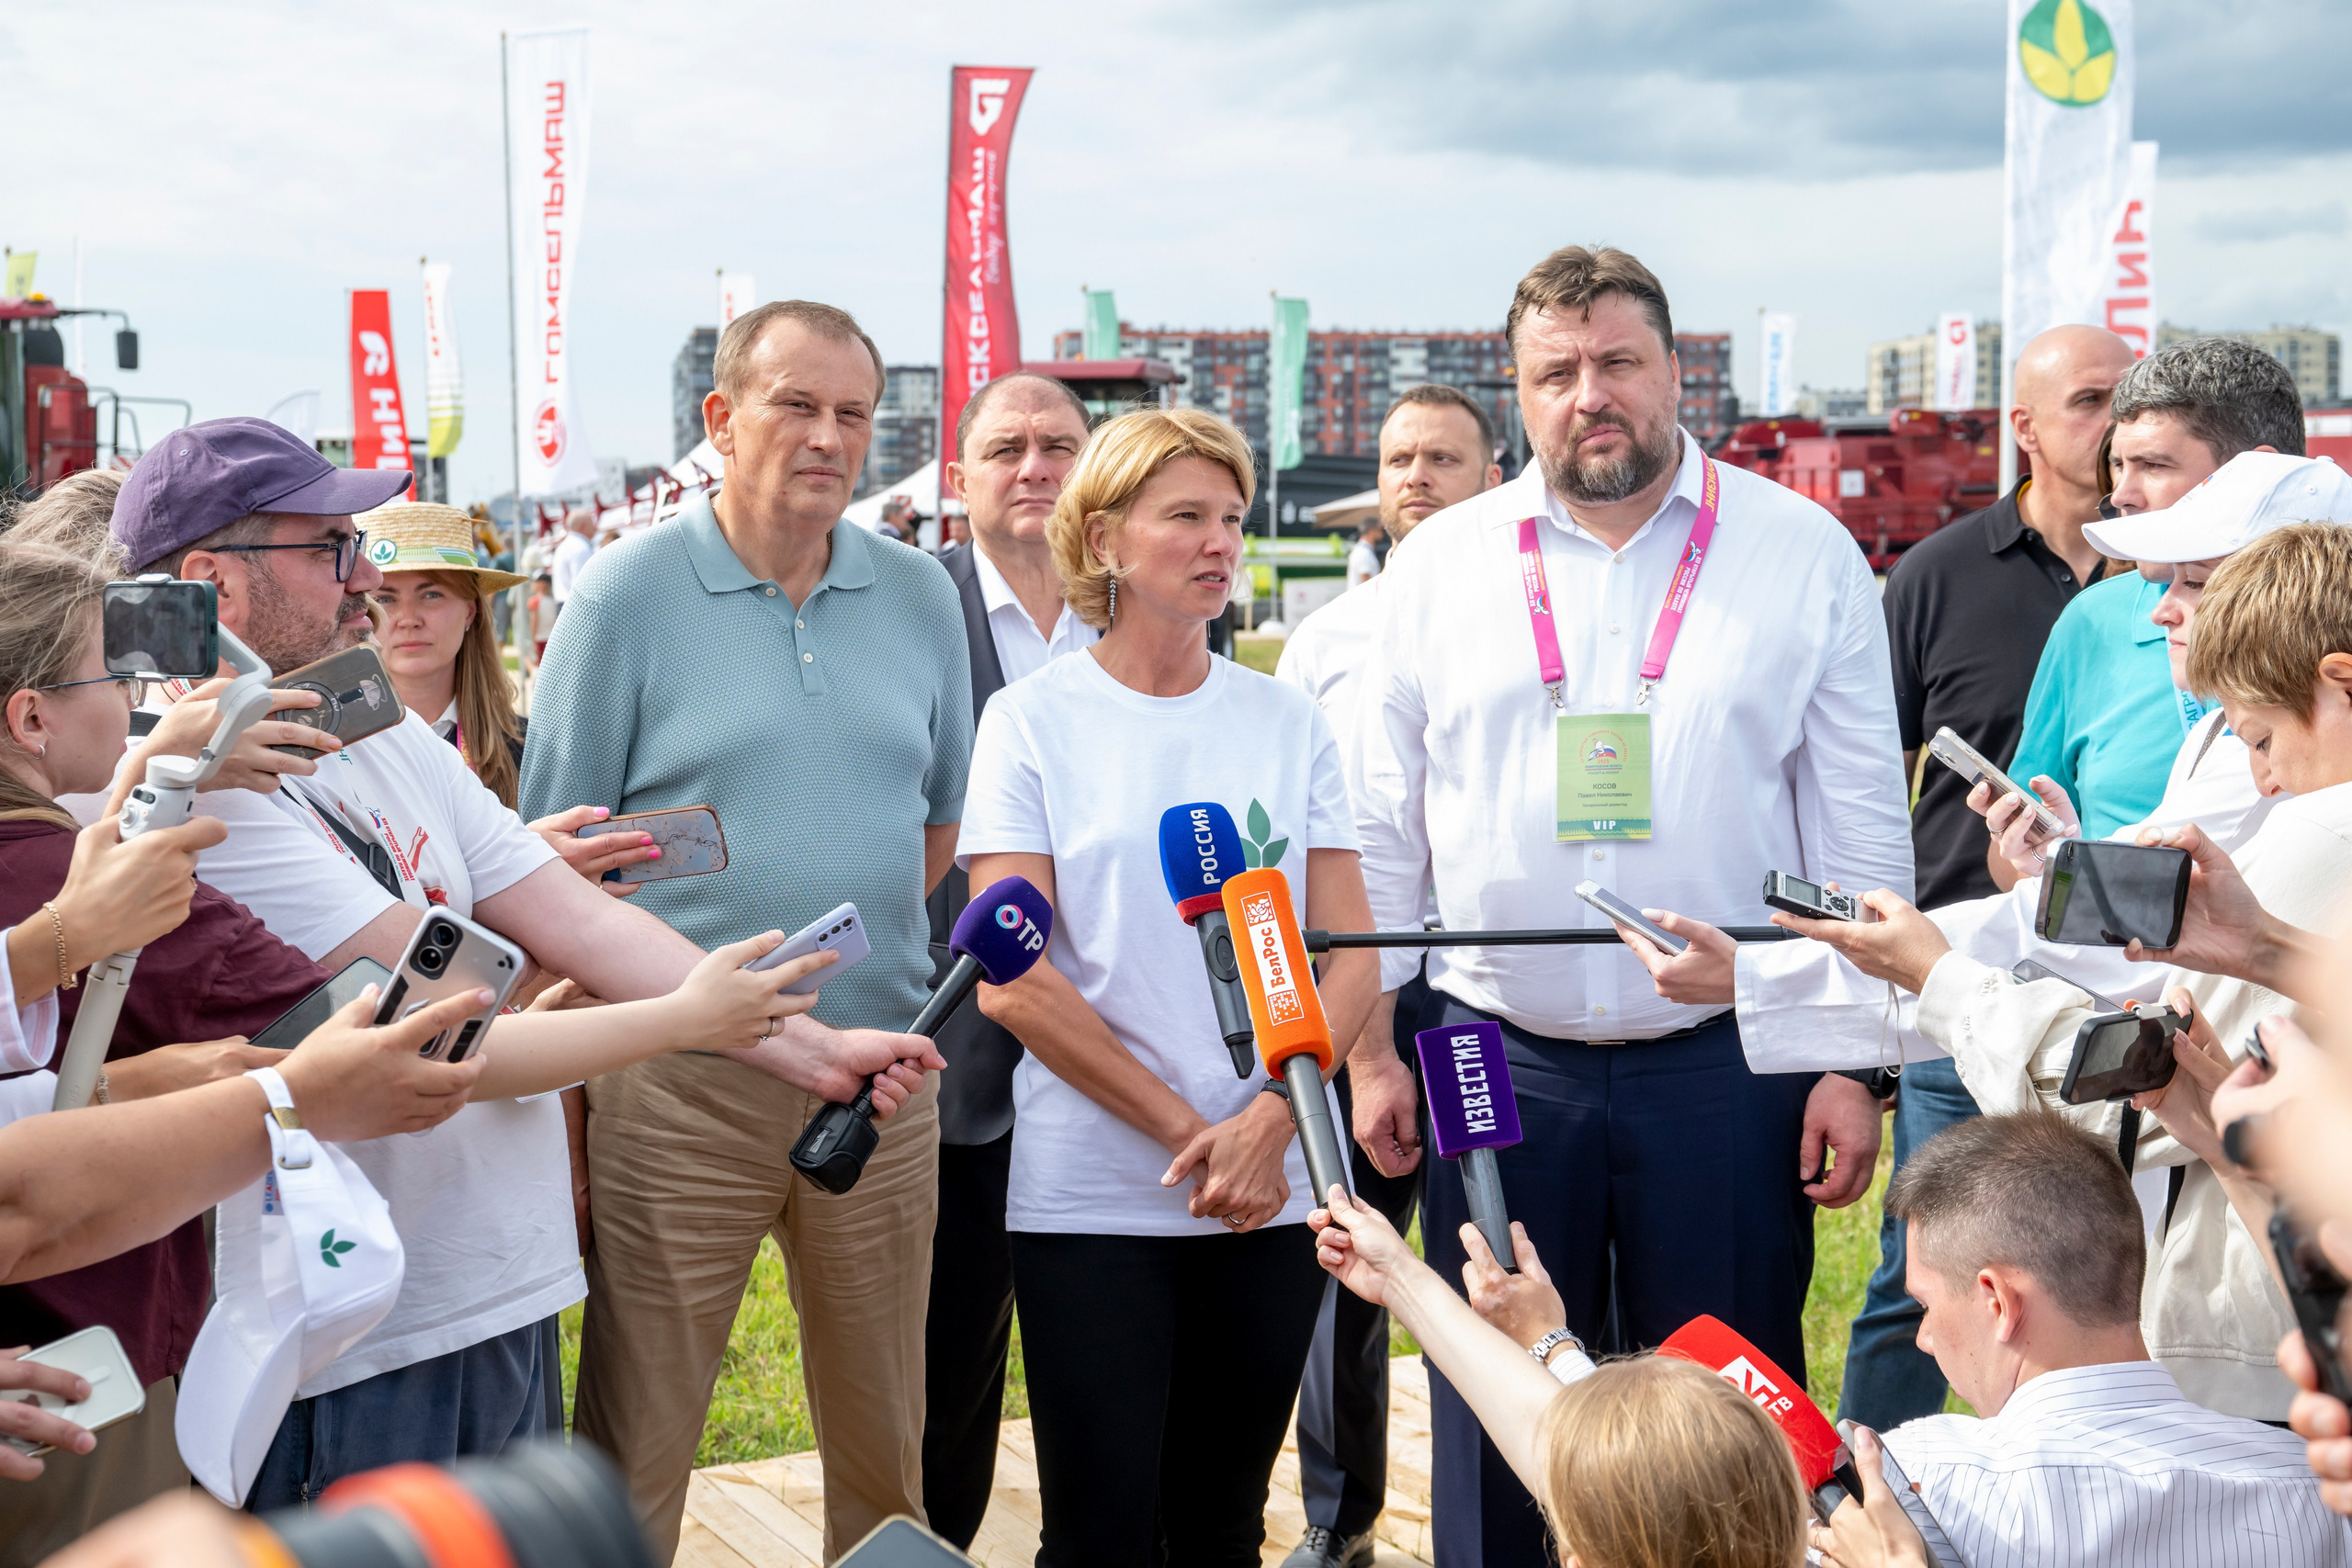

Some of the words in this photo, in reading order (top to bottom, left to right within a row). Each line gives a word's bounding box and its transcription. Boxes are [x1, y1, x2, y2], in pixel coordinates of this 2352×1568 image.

[543, 81, 566, 383] ГОМСЕЛЬМАШ
[1190, 808, 1221, 886] РОССИЯ
[1593, 820, 1617, 830] VIP
[384, 832, 399, 854] РОССИИ
[398, 861, 411, 883] ПАХОТЕ
[1261, 927, 1286, 988] БелРос
[1450, 1034, 1497, 1134] ИЗВЕСТИЯ
[1767, 1396, 1793, 1416] ТВ
